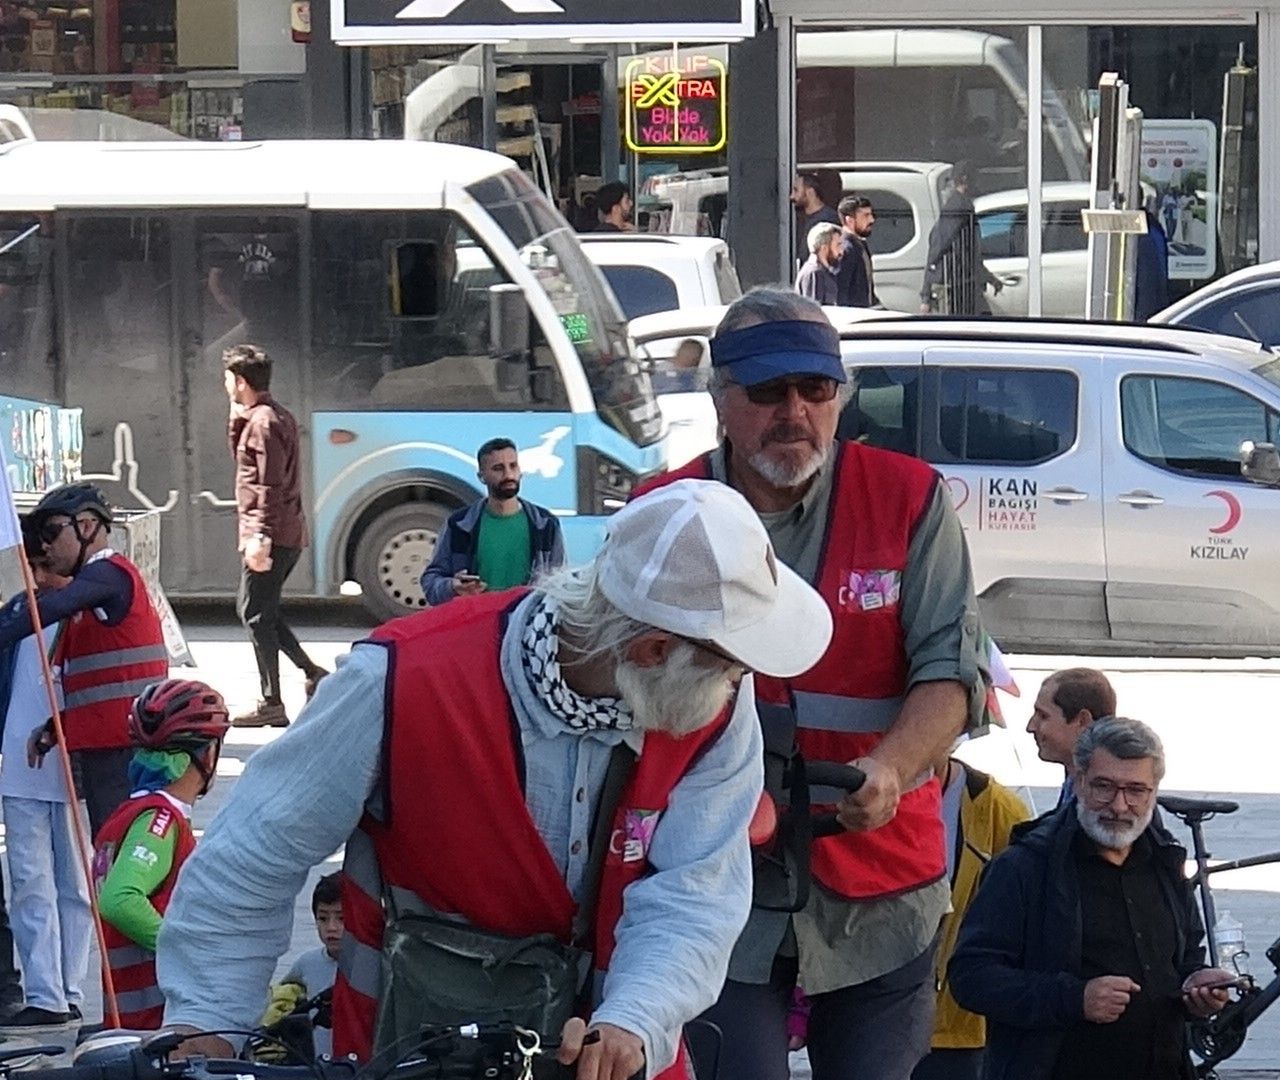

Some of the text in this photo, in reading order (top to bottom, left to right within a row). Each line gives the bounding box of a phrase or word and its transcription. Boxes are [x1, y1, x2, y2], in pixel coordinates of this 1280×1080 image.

[631, 72, 716, 108] EXTRA
[988, 477, 1038, 497] KAN
[988, 511, 1037, 523] HAYAT
[1190, 546, 1249, 560] KIZILAY
